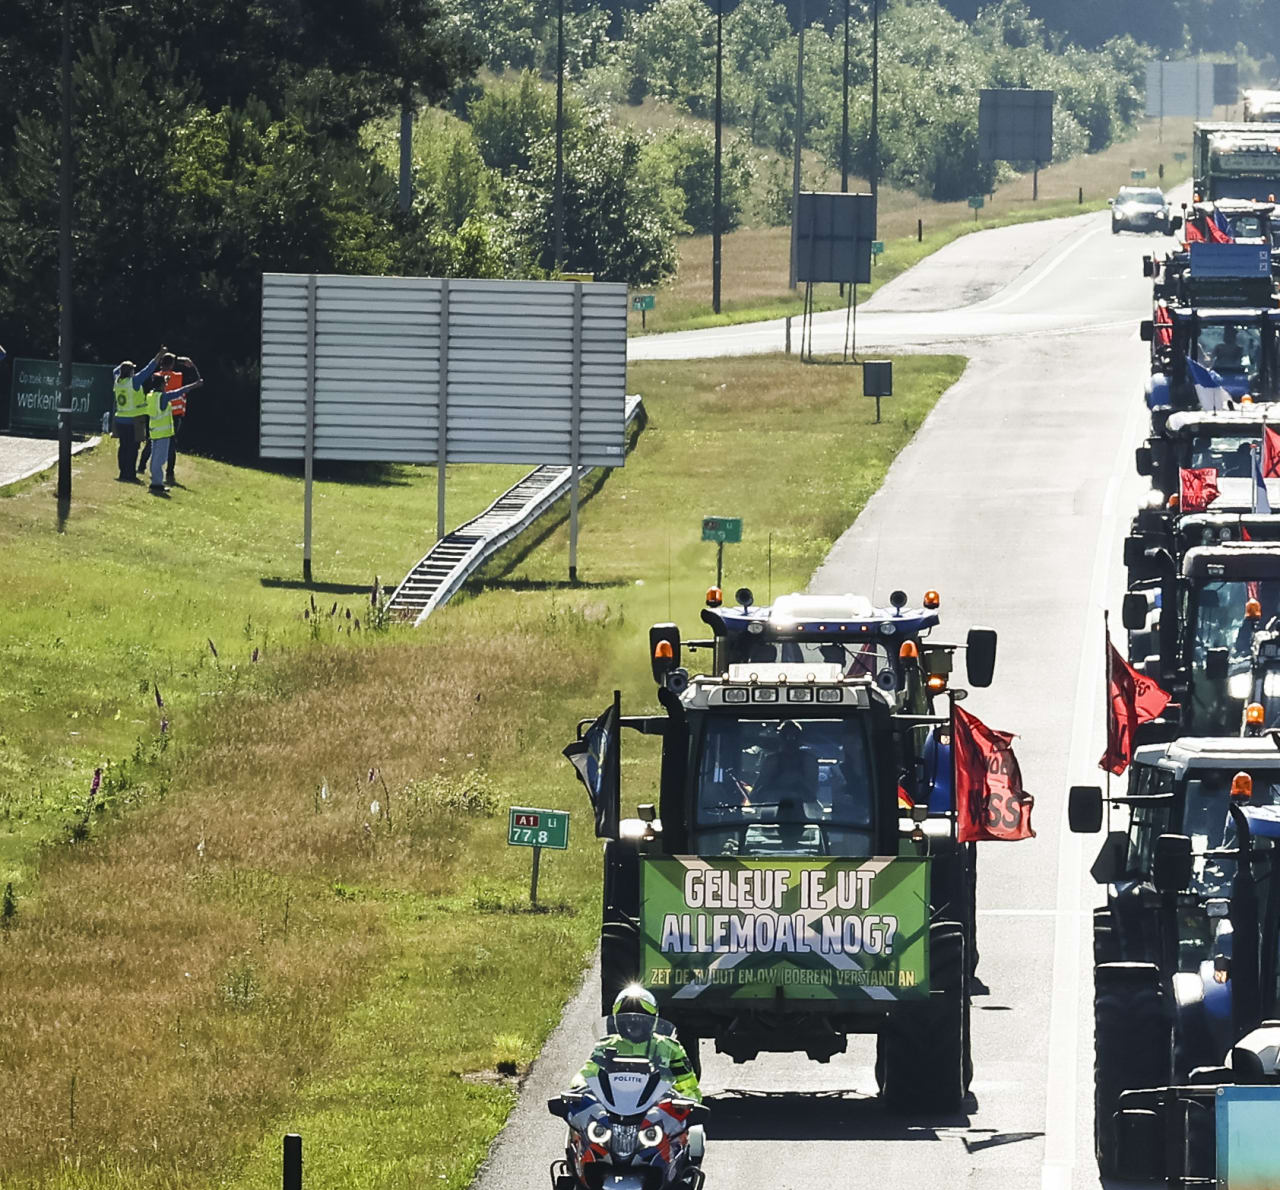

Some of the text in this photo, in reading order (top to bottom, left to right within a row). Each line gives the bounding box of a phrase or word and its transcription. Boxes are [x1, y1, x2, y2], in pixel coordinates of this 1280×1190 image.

[519, 815, 556, 828] A1 Li
[513, 828, 548, 844] 77,8
[684, 870, 876, 909] GELEUF IE UT
[661, 913, 898, 954] ALLEMOAL NOG?
[650, 968, 671, 986] ZET
[674, 969, 690, 986] DE
[693, 968, 709, 986] TV
[738, 969, 752, 986] EN
[781, 969, 832, 987] (BOEREN)
[836, 970, 895, 987] VERSTAND
[613, 1075, 642, 1083] POLITIE
